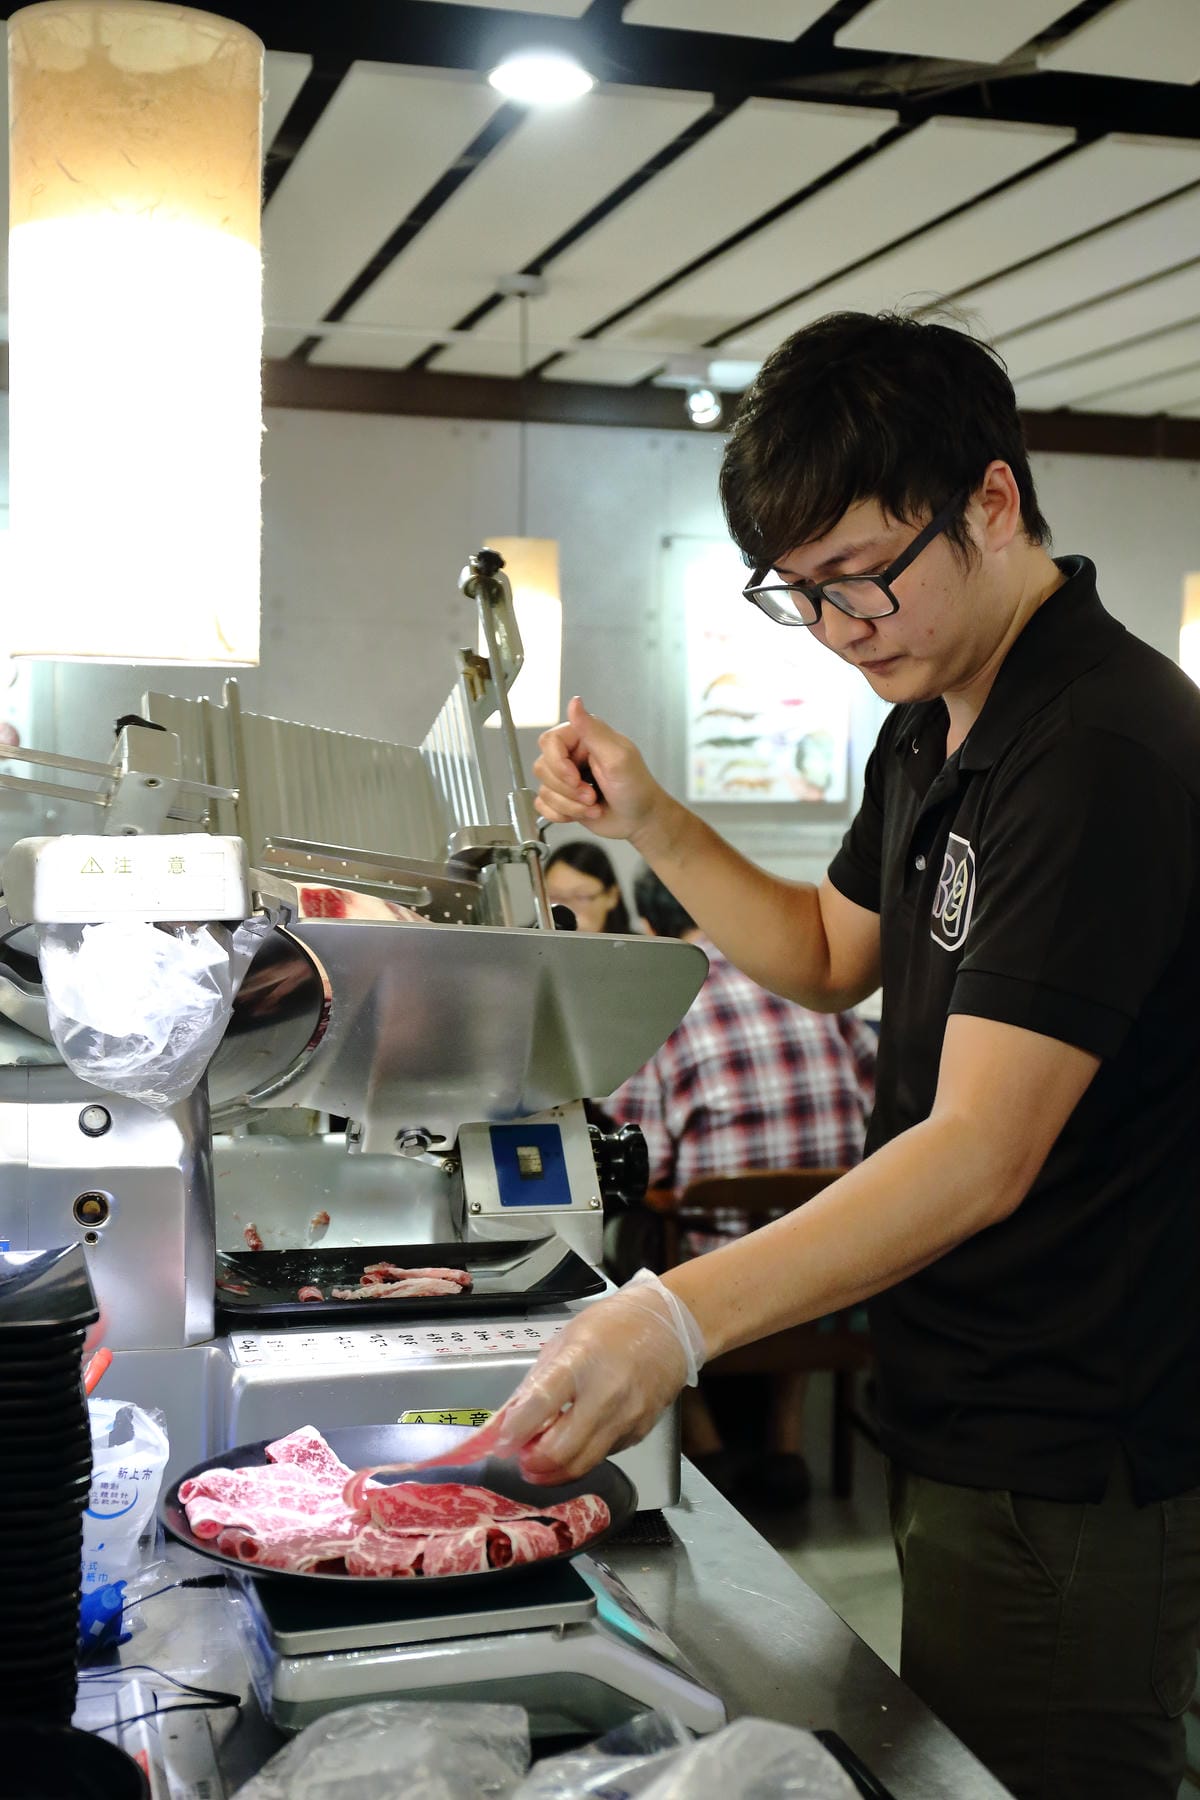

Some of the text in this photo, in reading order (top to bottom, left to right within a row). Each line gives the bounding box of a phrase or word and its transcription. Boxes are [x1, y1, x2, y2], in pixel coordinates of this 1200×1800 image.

[113, 856, 186, 874] 注意
[117, 1467, 153, 1480] 新上市
